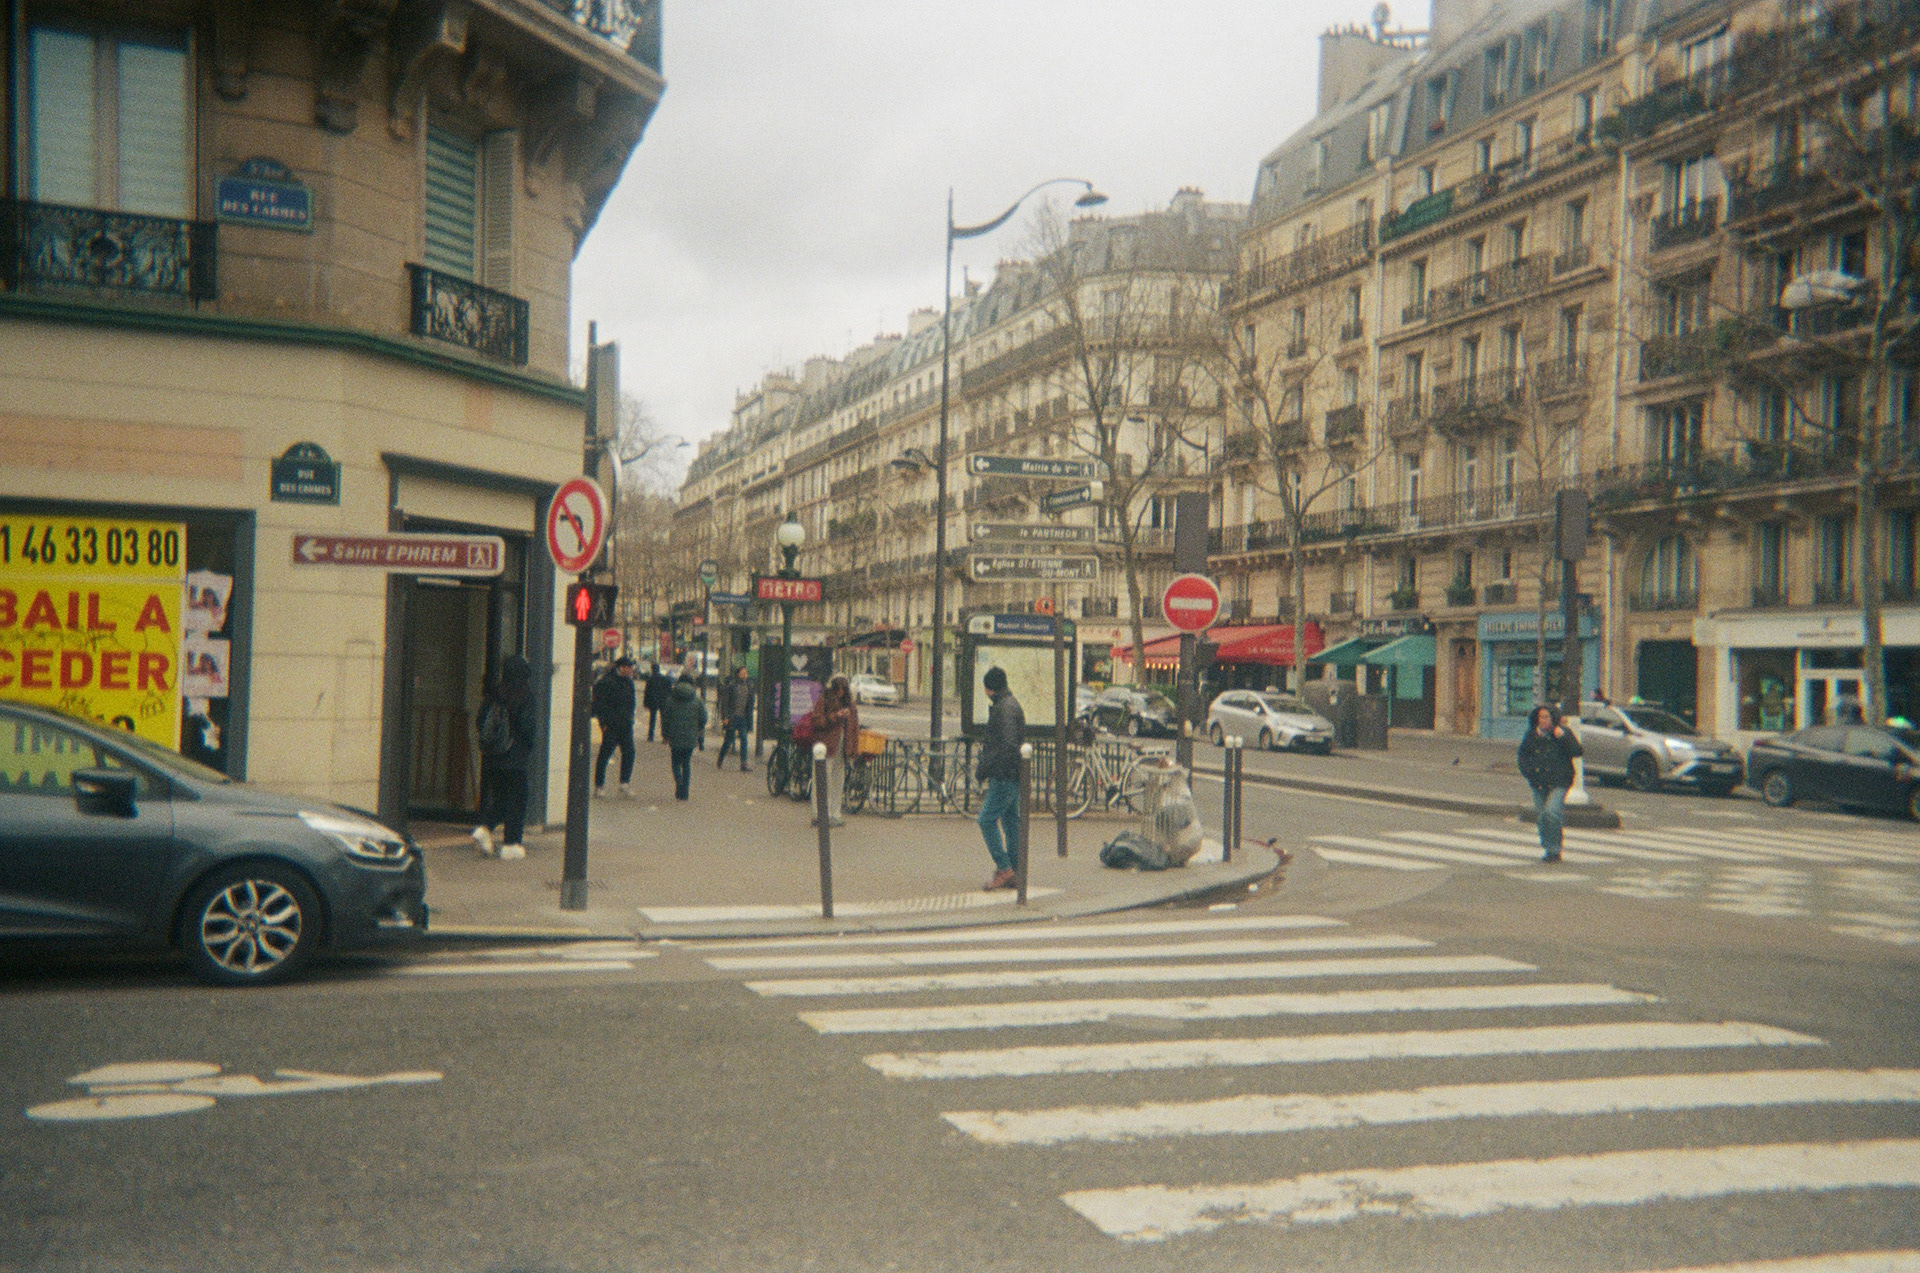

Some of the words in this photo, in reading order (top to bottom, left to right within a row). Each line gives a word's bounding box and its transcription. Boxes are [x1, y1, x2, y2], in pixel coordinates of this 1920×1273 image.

[250, 189, 278, 202] RUE
[222, 200, 250, 214] DES
[1021, 461, 1049, 472] Mairie
[22, 525, 57, 564] 46
[65, 526, 98, 565] 33
[106, 527, 139, 565] 03
[148, 528, 179, 566] 80
[332, 543, 378, 561] Saint
[386, 545, 456, 563] EPHREM
[134, 593, 171, 632] A
